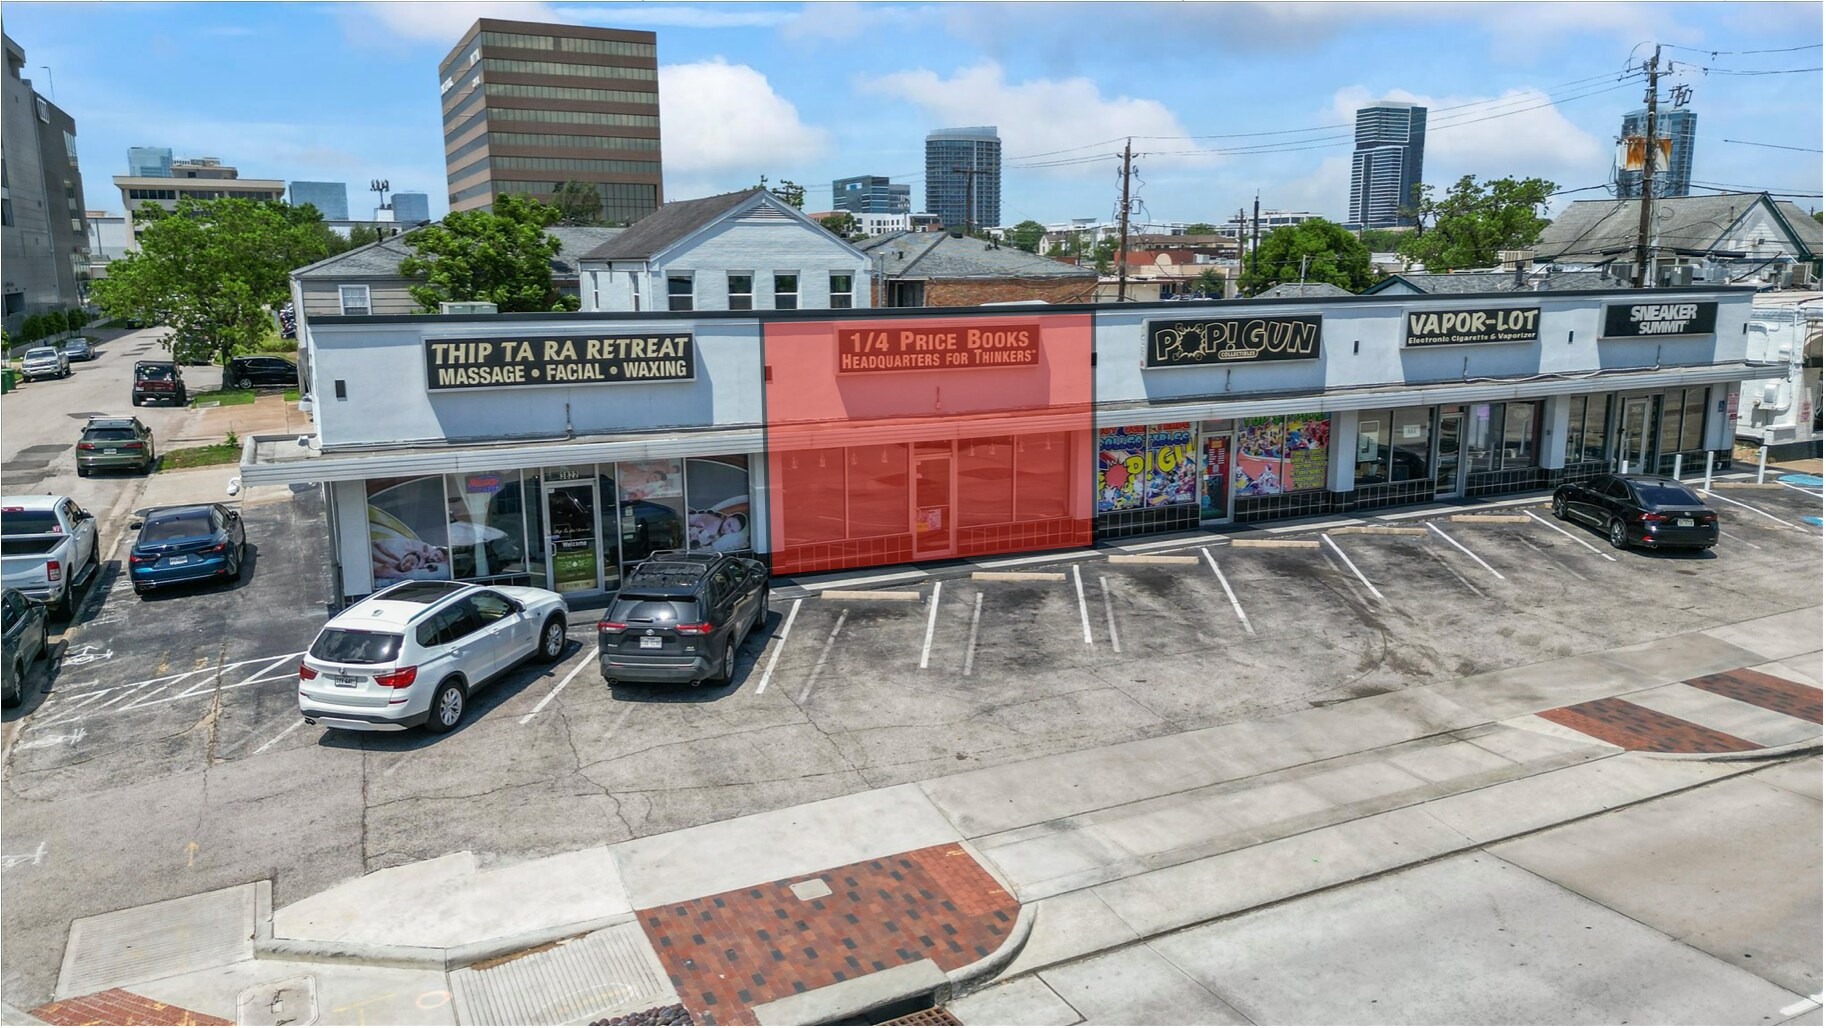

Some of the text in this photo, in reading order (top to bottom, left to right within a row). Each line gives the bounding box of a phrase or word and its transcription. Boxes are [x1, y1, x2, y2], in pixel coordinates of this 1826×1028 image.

[1410, 310, 1539, 335] VAPOR-LOT
[1630, 304, 1697, 322] SNEAKER
[1638, 321, 1684, 334] SUMMIT
[431, 337, 689, 365] THIP TA RA RETREAT
[850, 329, 1029, 353] 1/4 PRICE BOOKS
[438, 360, 687, 385] MASSAGE FACIAL WAXING
[842, 353, 940, 369] HEADQUARTERS
[946, 352, 969, 365] FOR
